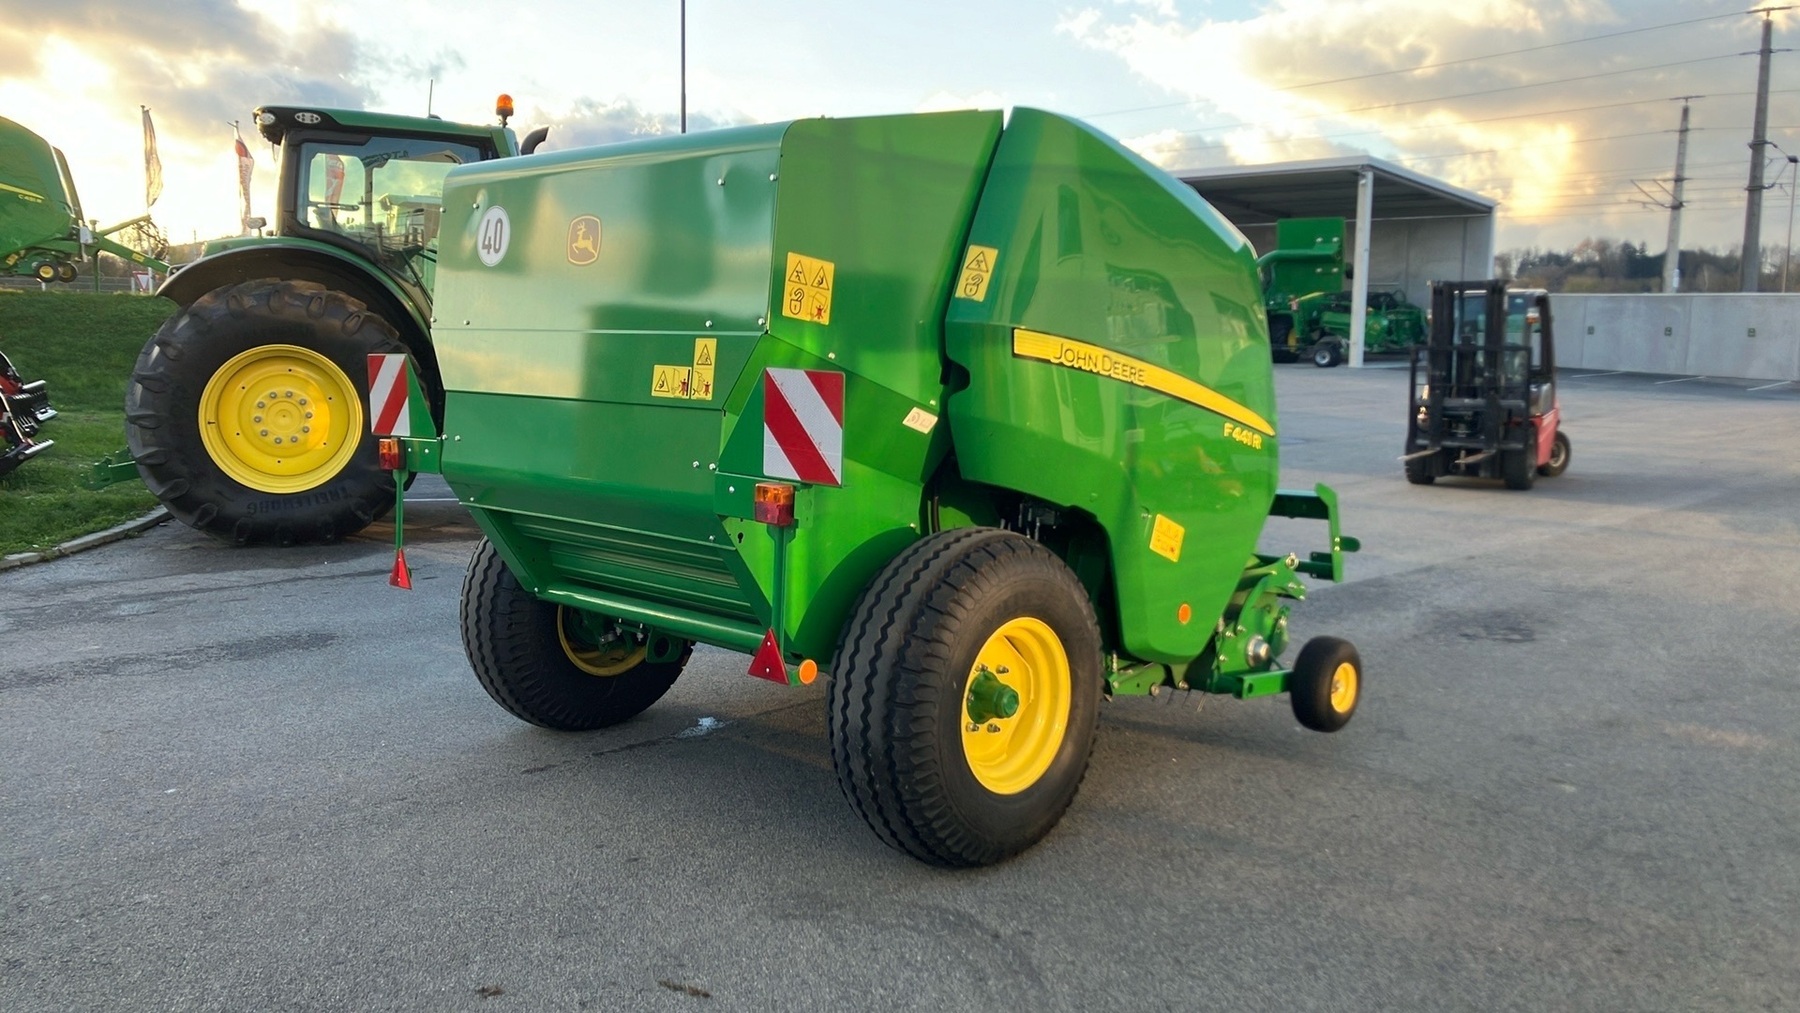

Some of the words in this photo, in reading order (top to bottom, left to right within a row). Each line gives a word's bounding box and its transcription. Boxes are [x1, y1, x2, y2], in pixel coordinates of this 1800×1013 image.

[481, 217, 503, 254] 40
[1052, 342, 1098, 370] JOHN
[1101, 354, 1146, 384] DEERE
